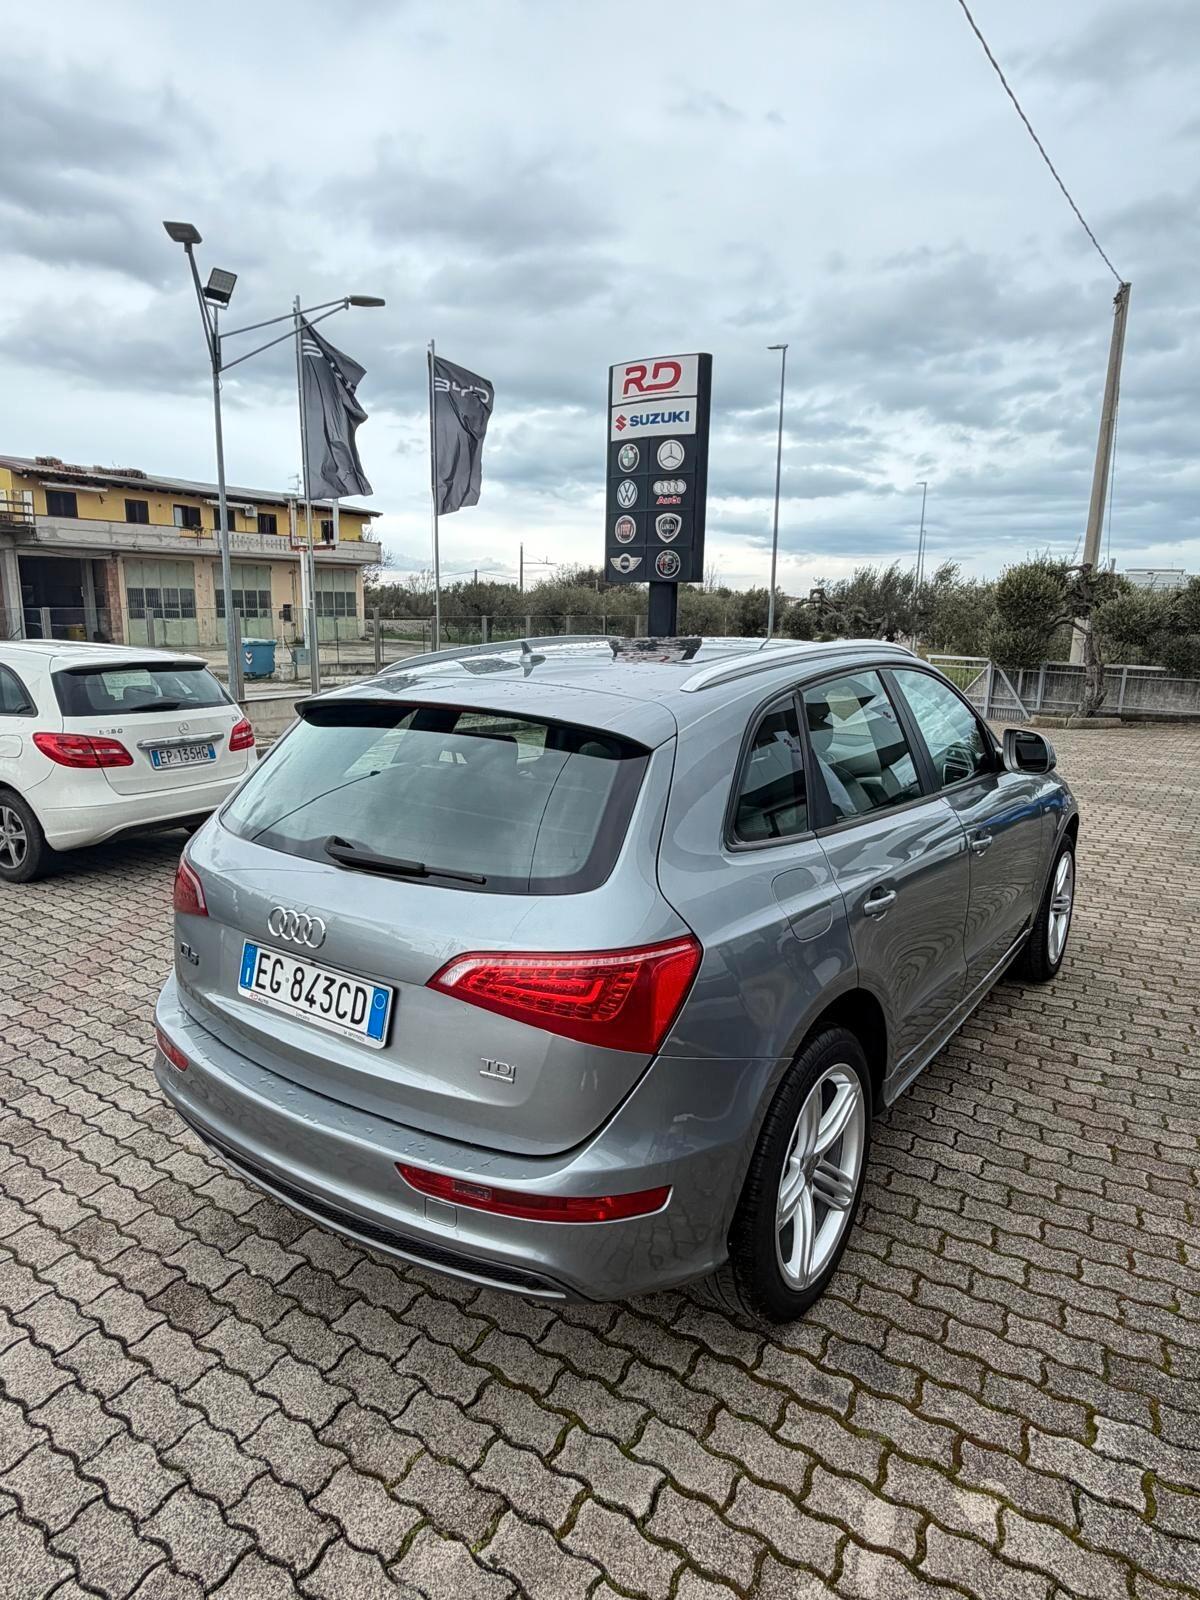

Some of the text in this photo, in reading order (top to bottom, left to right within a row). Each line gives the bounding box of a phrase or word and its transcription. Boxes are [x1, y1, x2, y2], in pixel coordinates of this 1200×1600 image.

[623, 361, 682, 395] RD
[629, 410, 690, 427] SUZUKI
[655, 495, 682, 505] Audi
[160, 750, 173, 764] EP
[177, 745, 208, 761] 135HG
[254, 953, 284, 994] EG
[290, 966, 368, 1025] 843CD
[480, 1057, 517, 1078] TDI
